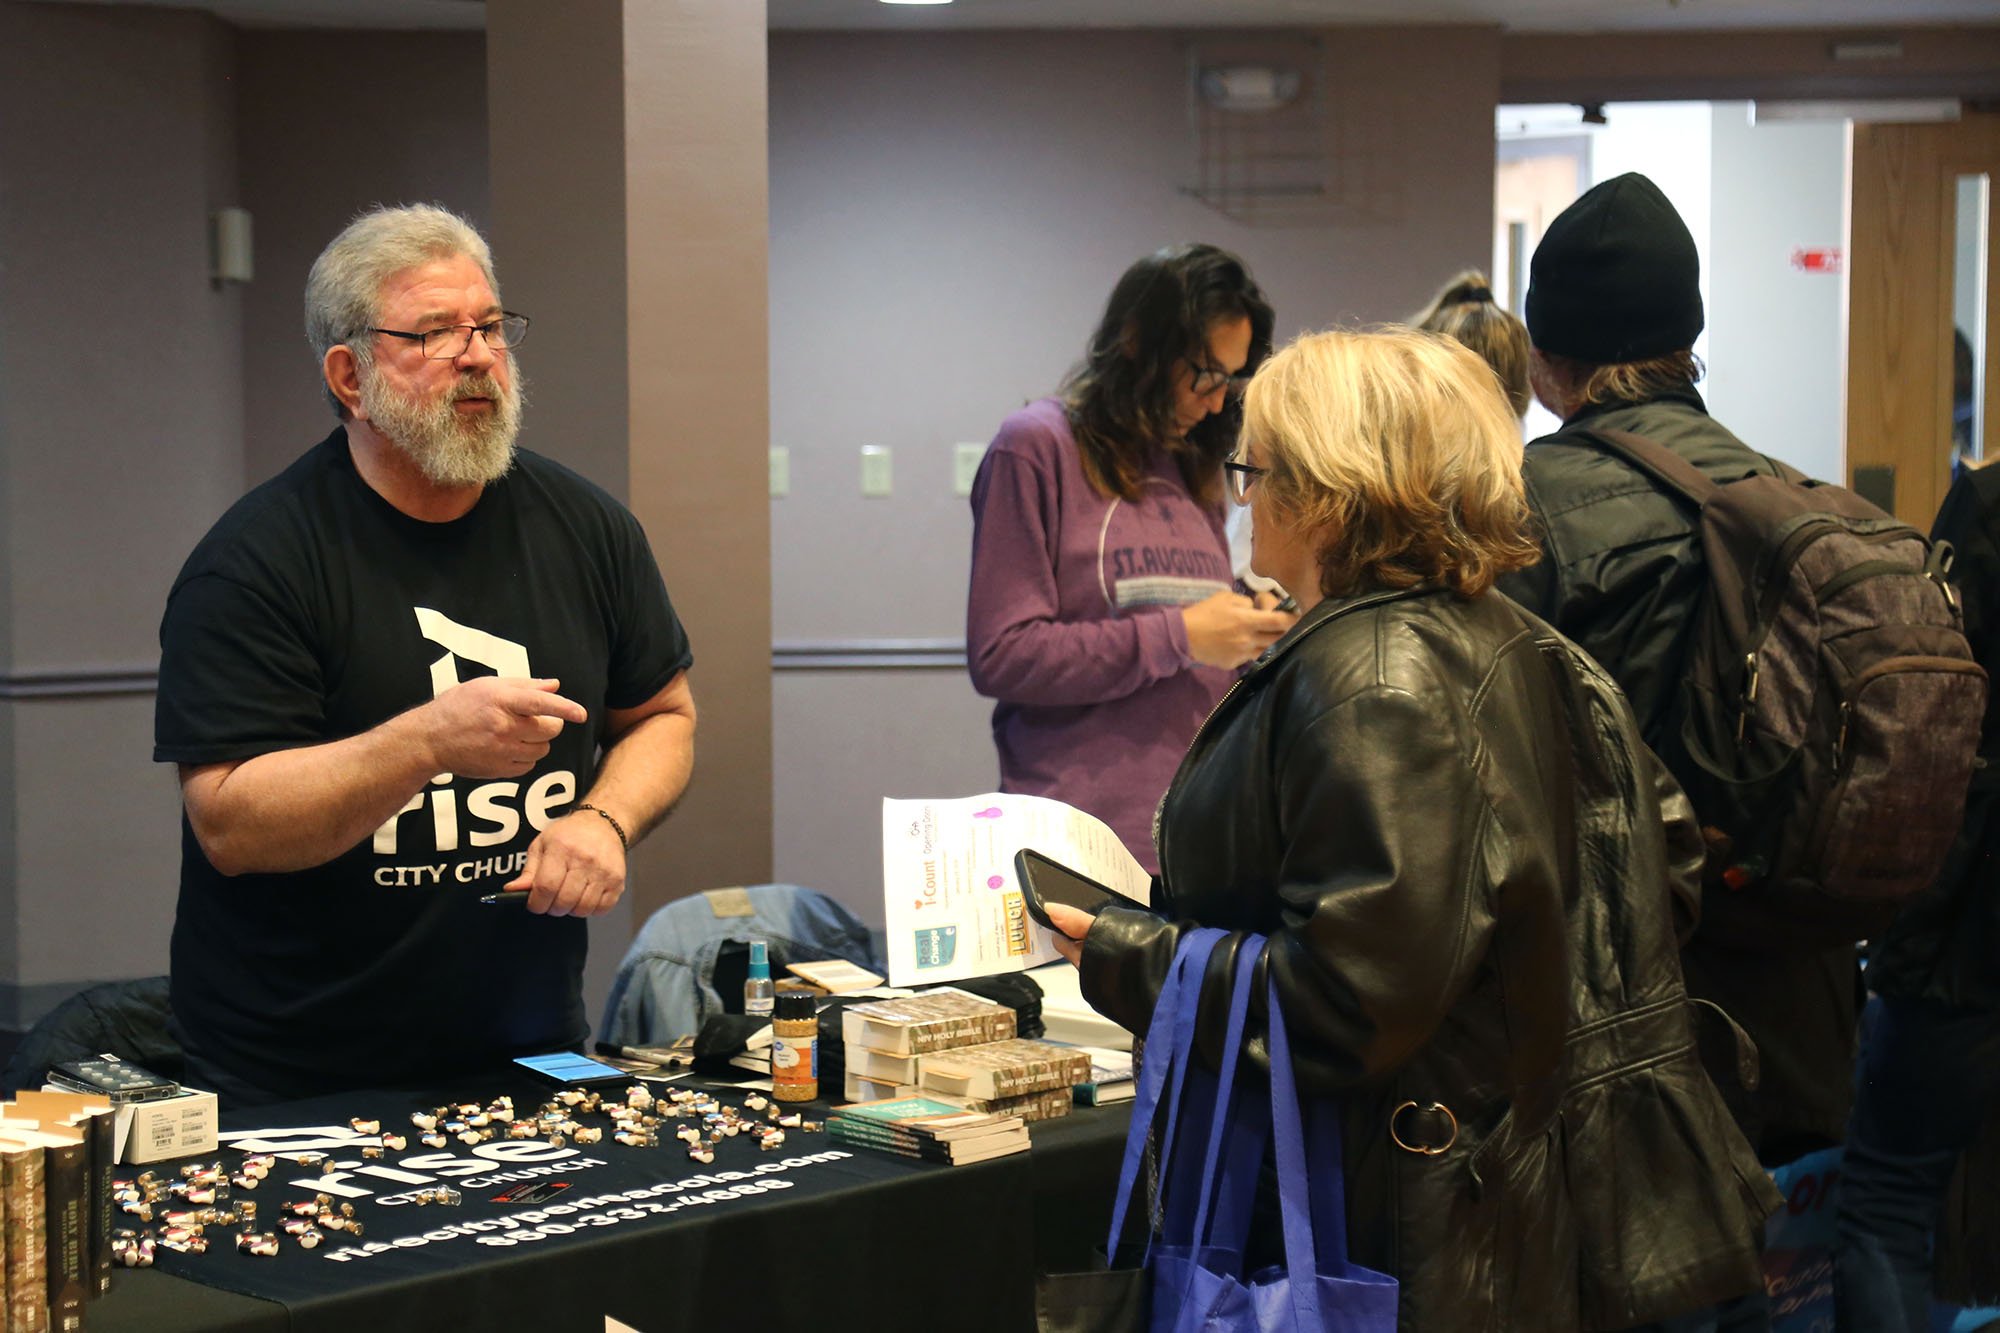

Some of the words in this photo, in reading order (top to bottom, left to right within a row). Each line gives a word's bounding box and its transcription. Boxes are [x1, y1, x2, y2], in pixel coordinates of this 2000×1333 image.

[372, 770, 576, 854] rise
[373, 863, 447, 887] CITY
[455, 854, 528, 883] CHUR
[1008, 898, 1026, 953] LUNCH
[918, 934, 930, 965] Real
[930, 929, 941, 965] Change
[917, 1034, 932, 1044] NIV
[933, 1030, 956, 1041] HOLY
[957, 1026, 982, 1038] BIBLE
[1001, 1079, 1015, 1089] NIV
[1015, 1075, 1036, 1086] HOLY
[1036, 1071, 1060, 1083] BIBLE
[25, 1163, 34, 1190] NIV
[288, 1140, 581, 1199] rise
[459, 1158, 608, 1189] CHURCH
[25, 1193, 35, 1231] HOLY
[67, 1200, 78, 1235] HOLY
[323, 1150, 854, 1262] risecitypensacola.com
[25, 1234, 35, 1280] BIBLE
[68, 1241, 79, 1281] BIBLE
